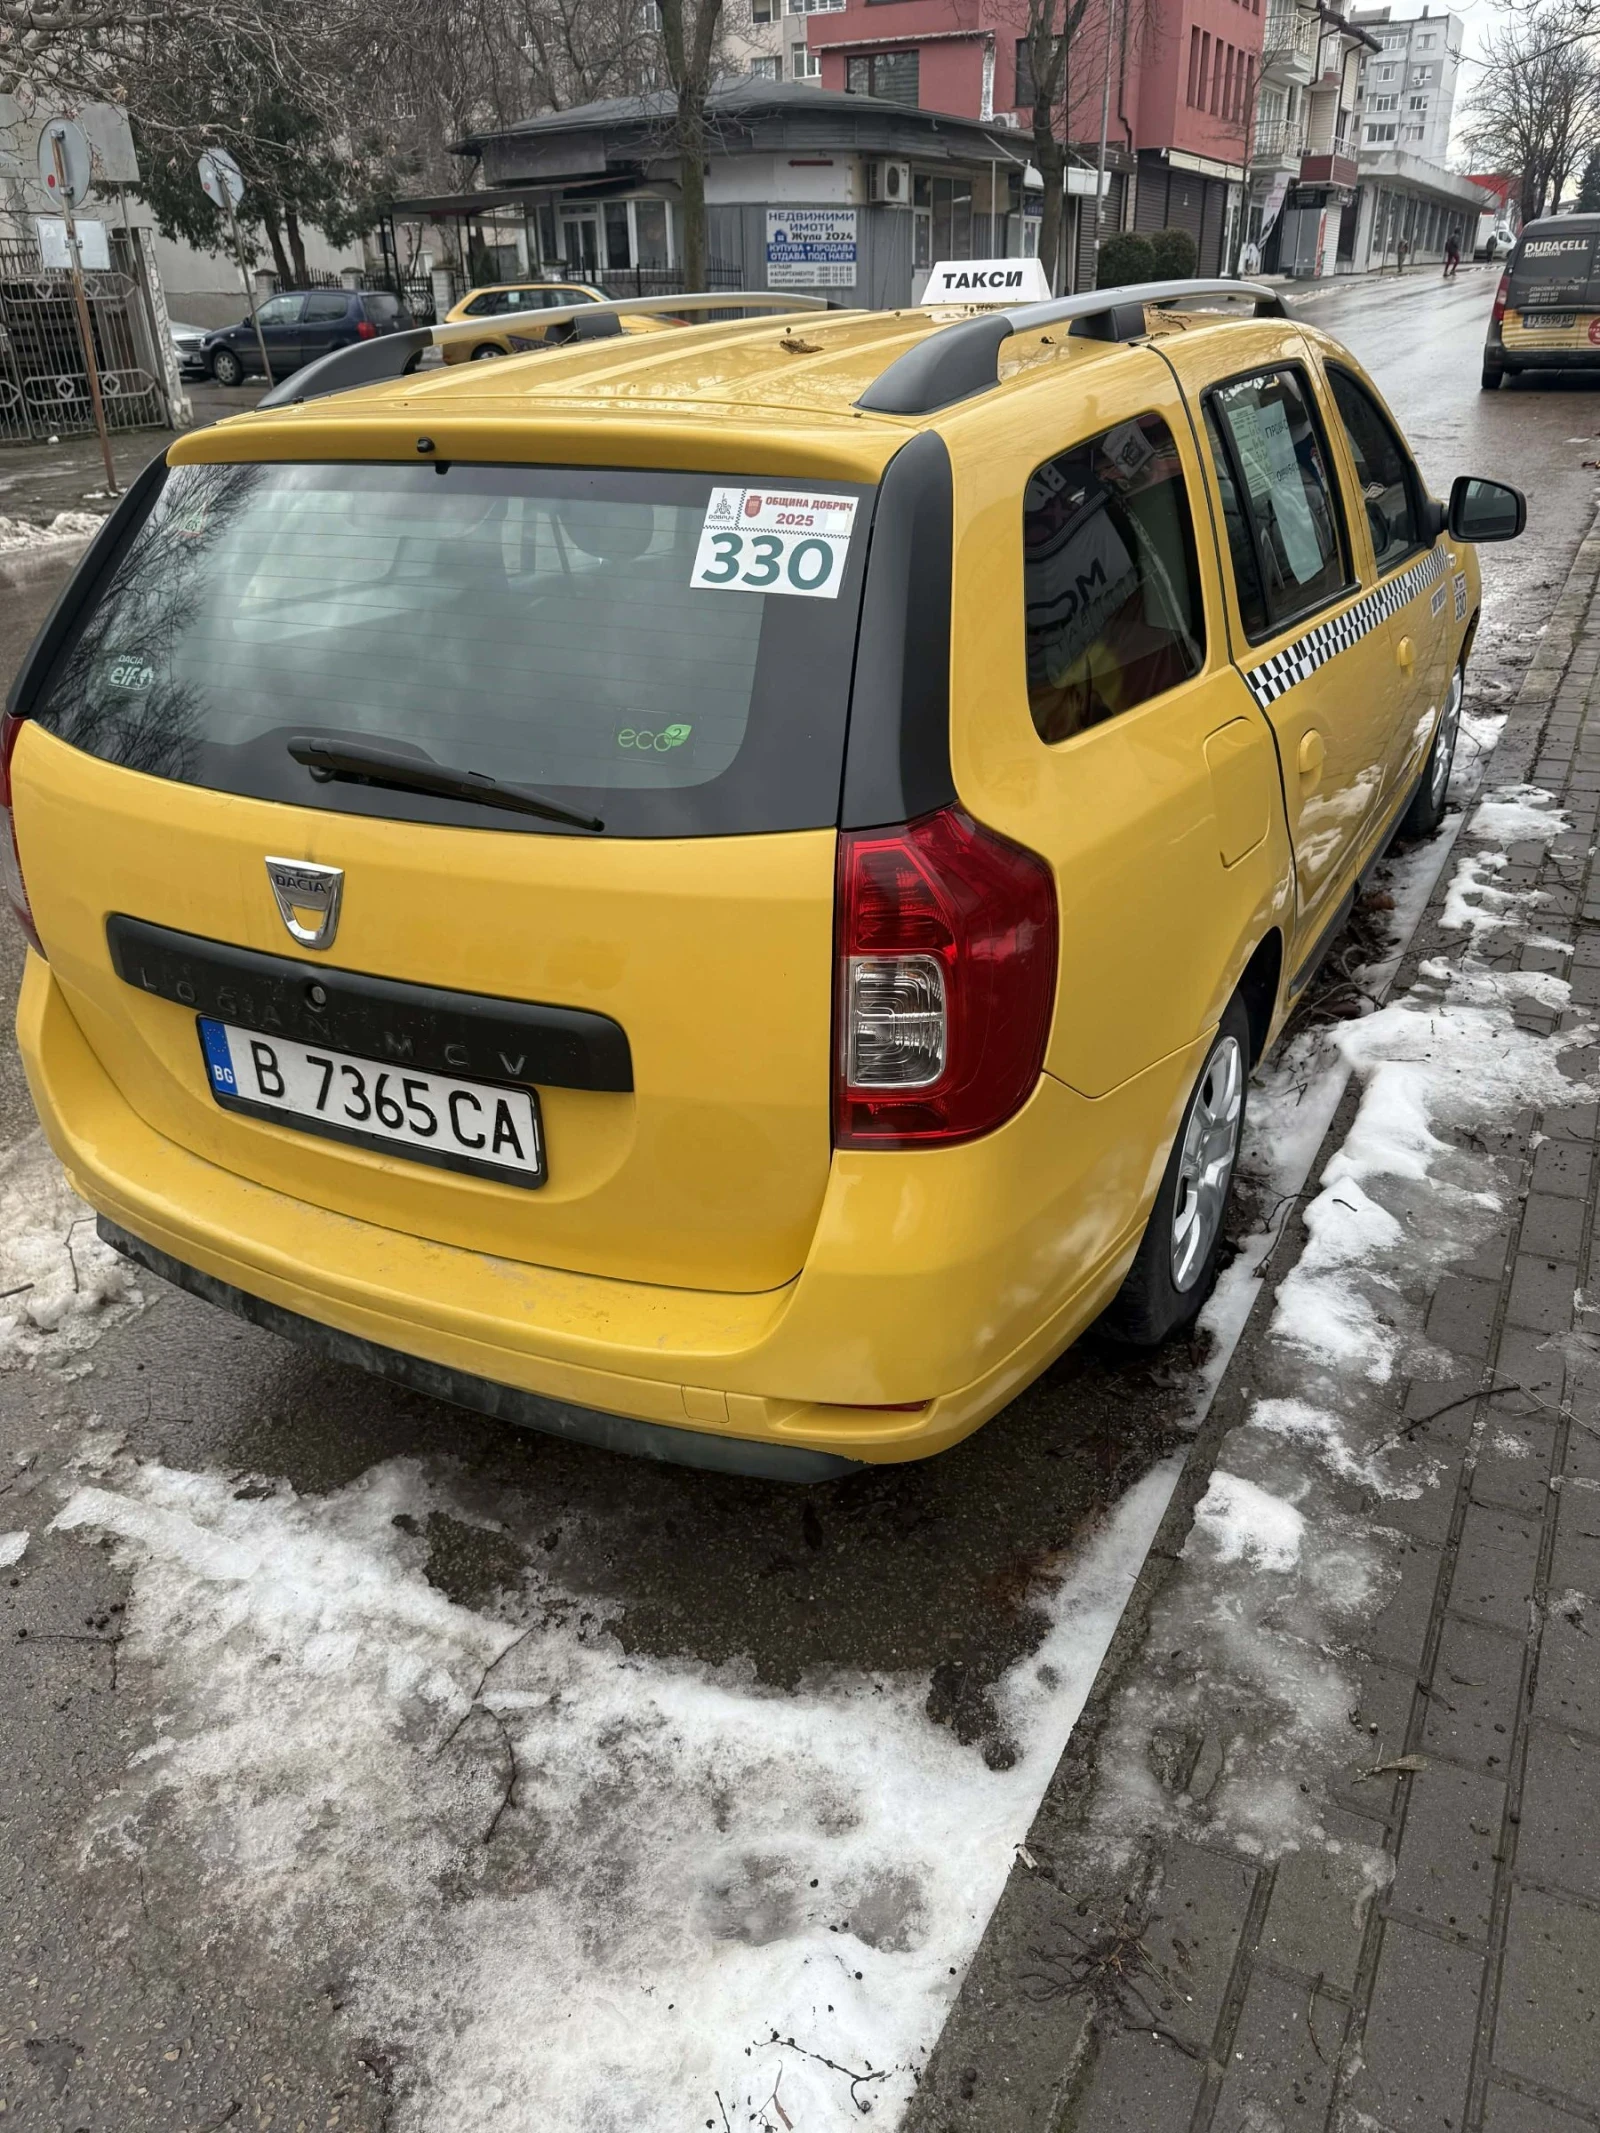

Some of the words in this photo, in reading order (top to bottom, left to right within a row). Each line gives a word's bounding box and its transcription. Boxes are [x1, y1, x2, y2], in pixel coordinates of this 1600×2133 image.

[769, 212, 854, 222] НЕДВИЖИМИ
[790, 223, 834, 232] ИМОТИ
[825, 232, 853, 241] 2024
[769, 244, 804, 252] КУПУВА
[813, 244, 854, 252] ПРОДАВА
[1524, 239, 1589, 253] DURACELL
[770, 252, 806, 261] ОТДАВА
[808, 252, 826, 261] ПОД
[828, 252, 854, 260] НАЕМ
[942, 271, 1023, 289] ТАКСИ
[765, 496, 809, 509] ОБЩИНА
[776, 513, 815, 527] 2025
[701, 532, 834, 590] 330
[119, 655, 144, 665] DACIA
[110, 667, 141, 686] elf
[275, 874, 327, 894] DACIA
[140, 966, 334, 1038] LOGAN
[384, 1030, 528, 1075] MCV
[213, 1064, 234, 1084] BG
[250, 1040, 285, 1099] B
[306, 1054, 438, 1138] 7365
[449, 1090, 526, 1161] CA
